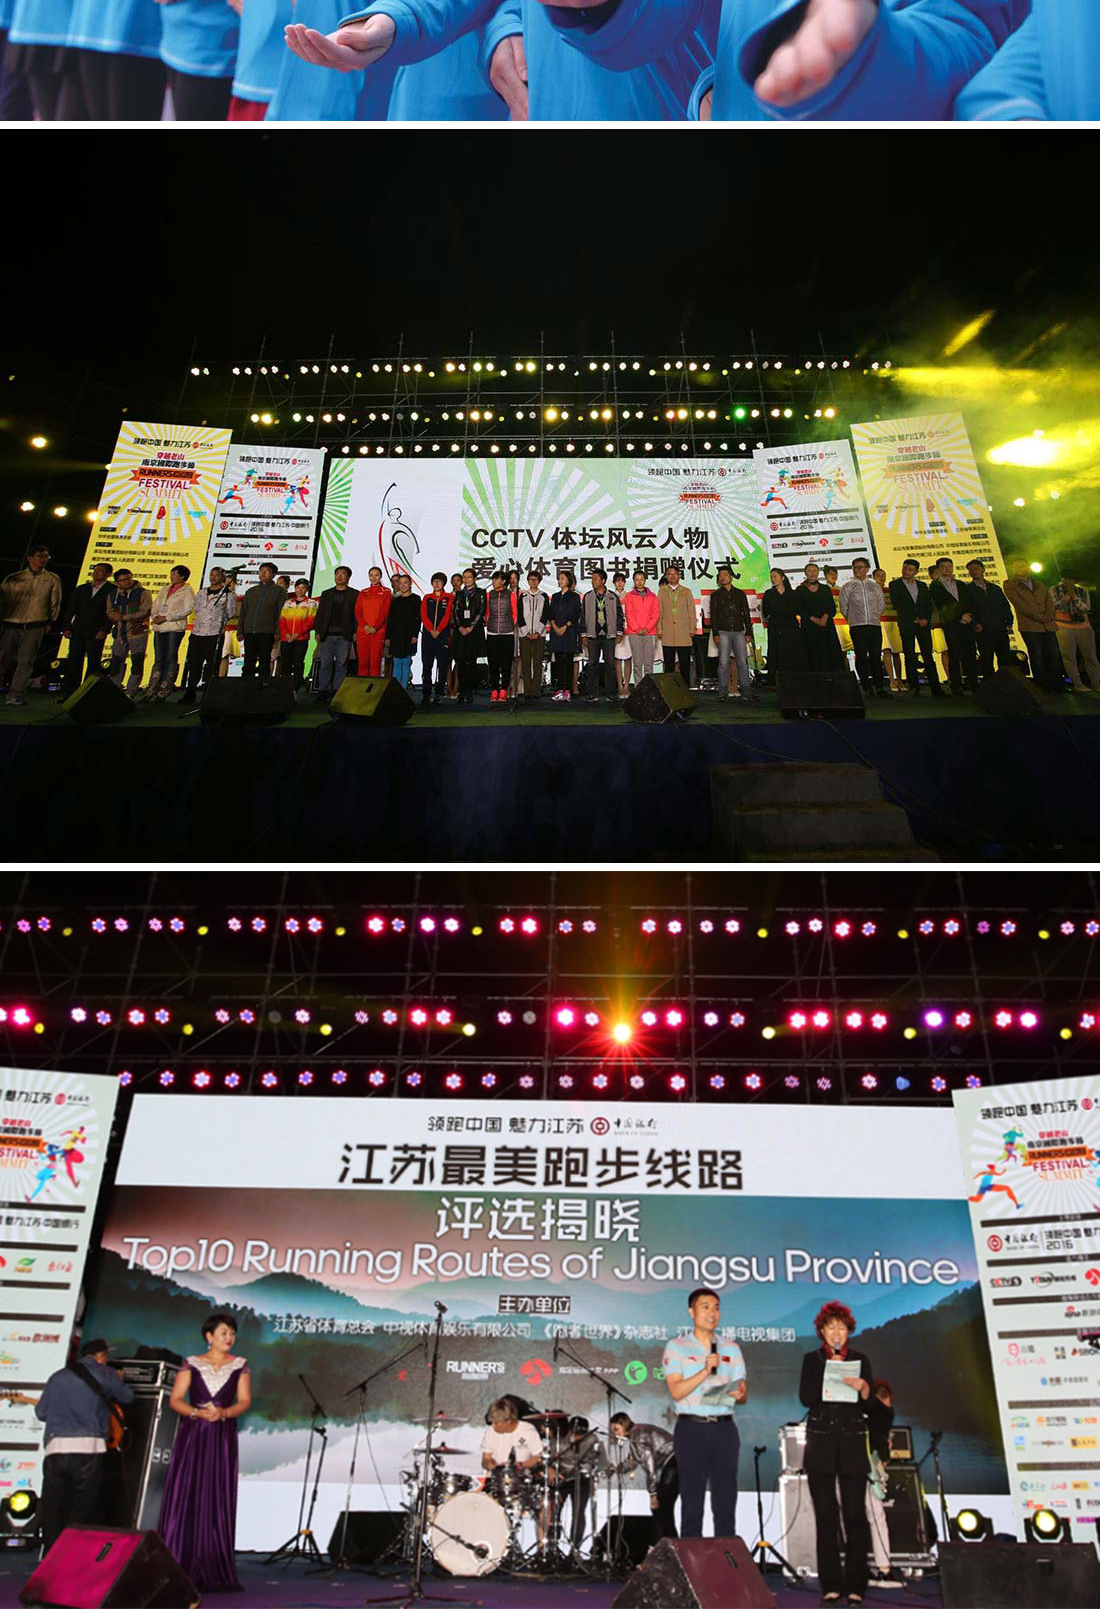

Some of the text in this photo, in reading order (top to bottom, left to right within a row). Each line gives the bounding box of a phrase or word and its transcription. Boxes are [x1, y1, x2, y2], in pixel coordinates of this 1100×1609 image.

[138, 478, 190, 490] FESTIVAL
[894, 471, 945, 483] FESTIVAL
[472, 527, 709, 549] CCTV 体坛风云人物
[5, 1090, 52, 1104] 魅力江苏
[980, 1099, 1078, 1119] 领跑中国 魅力江苏
[427, 1115, 502, 1133] 领跑中国
[509, 1117, 584, 1134] 魅力江苏
[339, 1143, 743, 1191] 江苏最美跑步线路
[1033, 1159, 1087, 1172] FESTIVAL
[436, 1196, 640, 1243] 评选揭晓
[1046, 1240, 1073, 1250] 2016
[123, 1237, 959, 1291] Top10 Running Routes of Jiangsu Province
[500, 1296, 570, 1313] 主办单位
[273, 1317, 375, 1334] 江苏省体育总会
[677, 1326, 796, 1342] 江播电视集团
[446, 1361, 505, 1373] RUNNER'S
